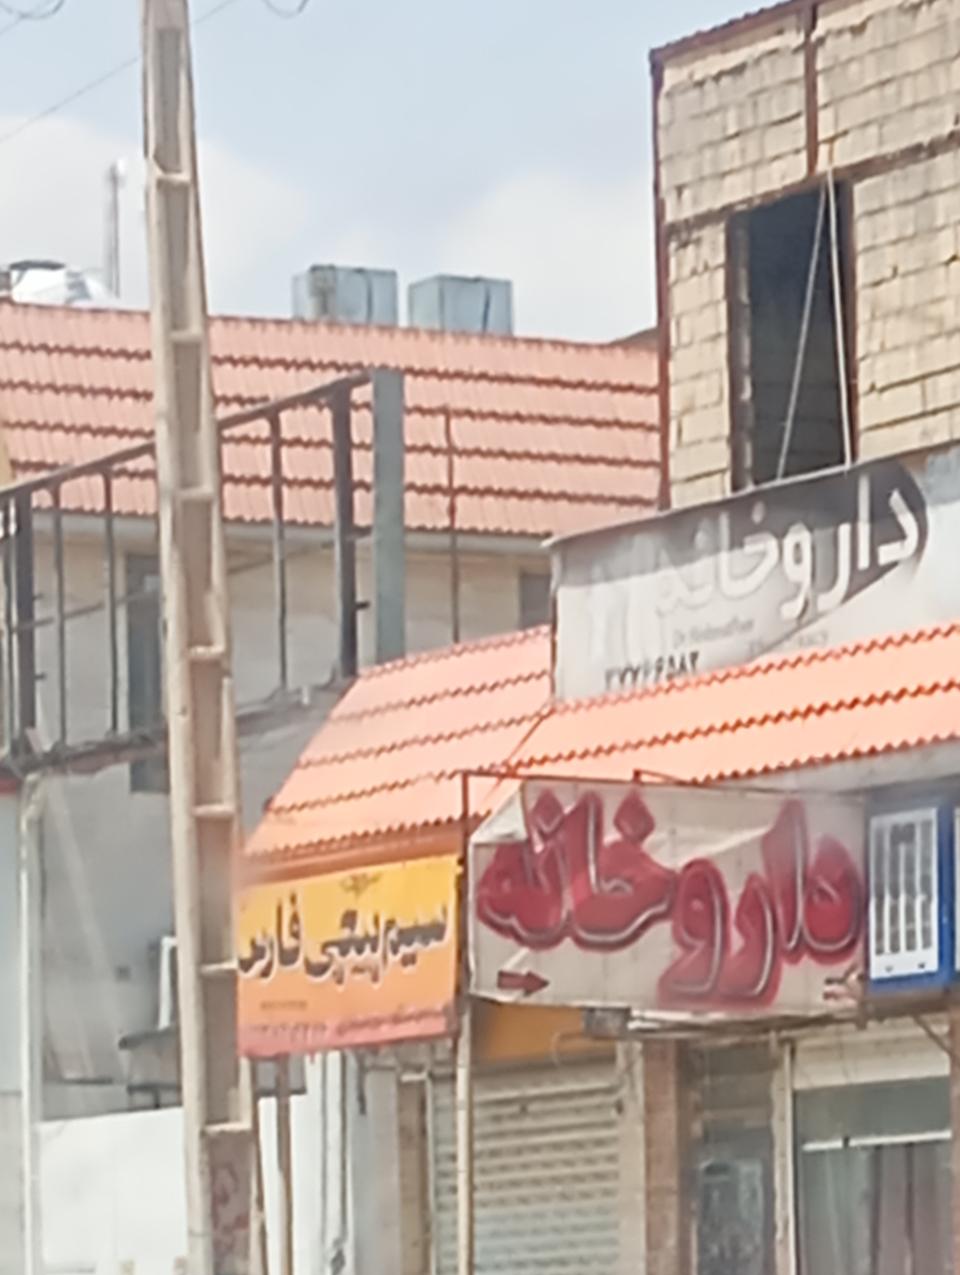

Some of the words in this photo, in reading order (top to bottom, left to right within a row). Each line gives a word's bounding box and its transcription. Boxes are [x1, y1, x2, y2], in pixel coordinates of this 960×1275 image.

[653, 473, 921, 620] داروخانه
[238, 890, 300, 979] فارس
[476, 788, 863, 1010] داروخانه
